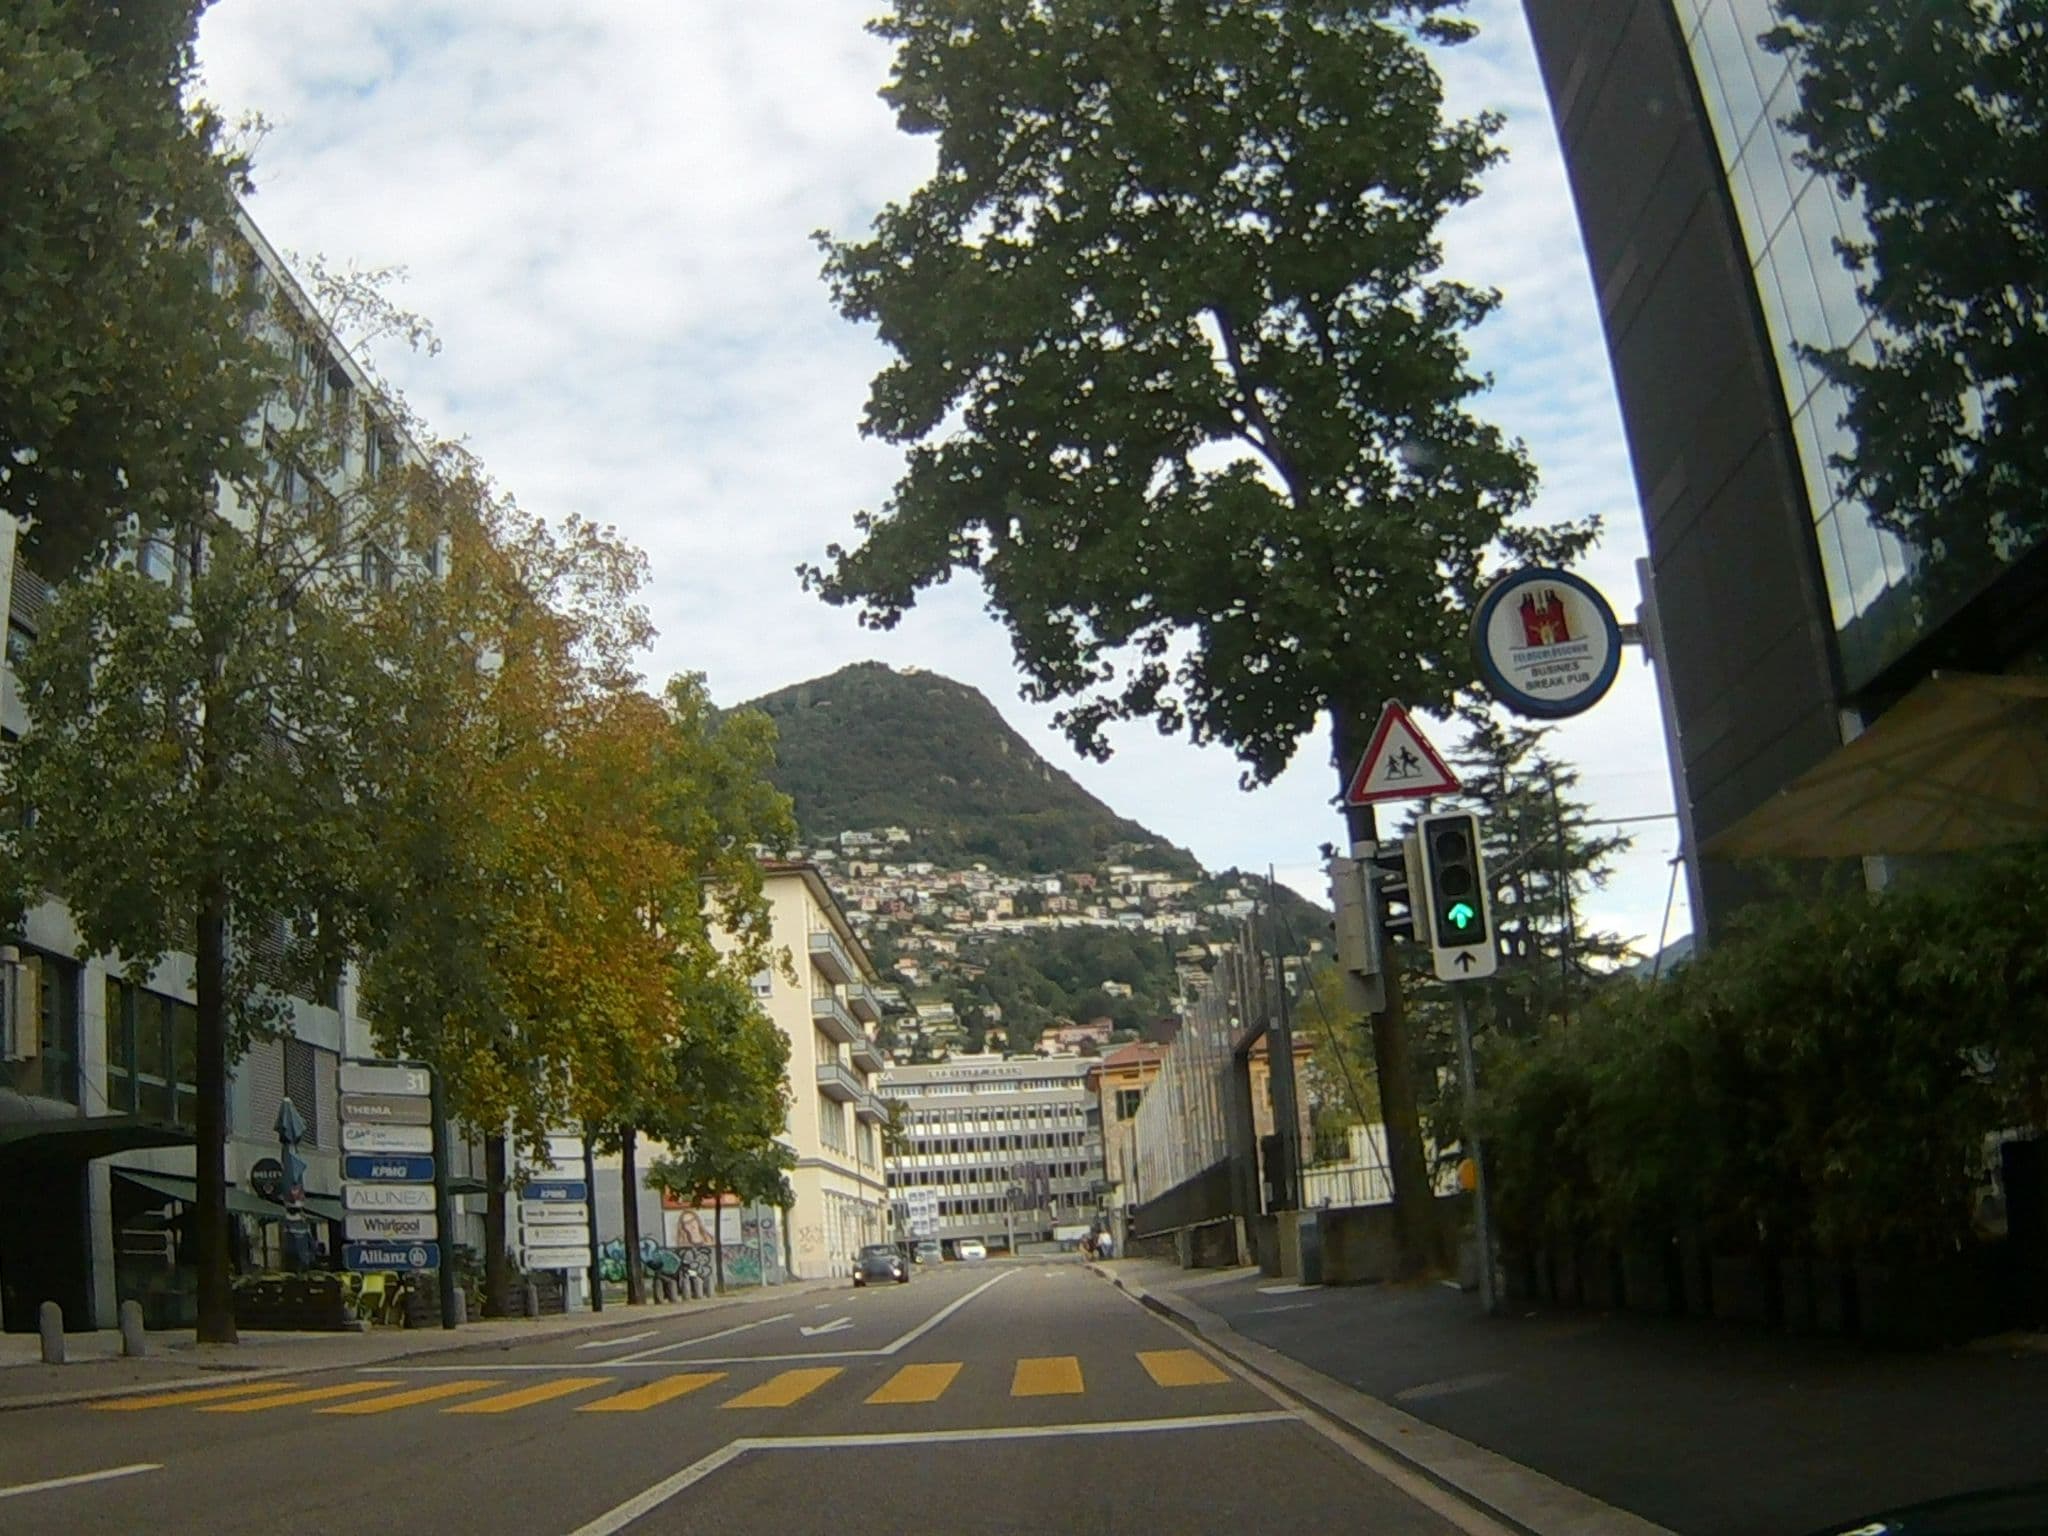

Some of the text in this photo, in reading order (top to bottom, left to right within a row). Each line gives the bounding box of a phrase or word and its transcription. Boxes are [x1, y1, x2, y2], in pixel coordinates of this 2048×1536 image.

[1526, 673, 1590, 690] BREAK PUB
[406, 1073, 425, 1090] 31
[345, 1105, 392, 1116] THEMA
[371, 1166, 408, 1177] KPMG
[364, 1217, 420, 1233] Whirlpool
[359, 1250, 407, 1264] Allianz
